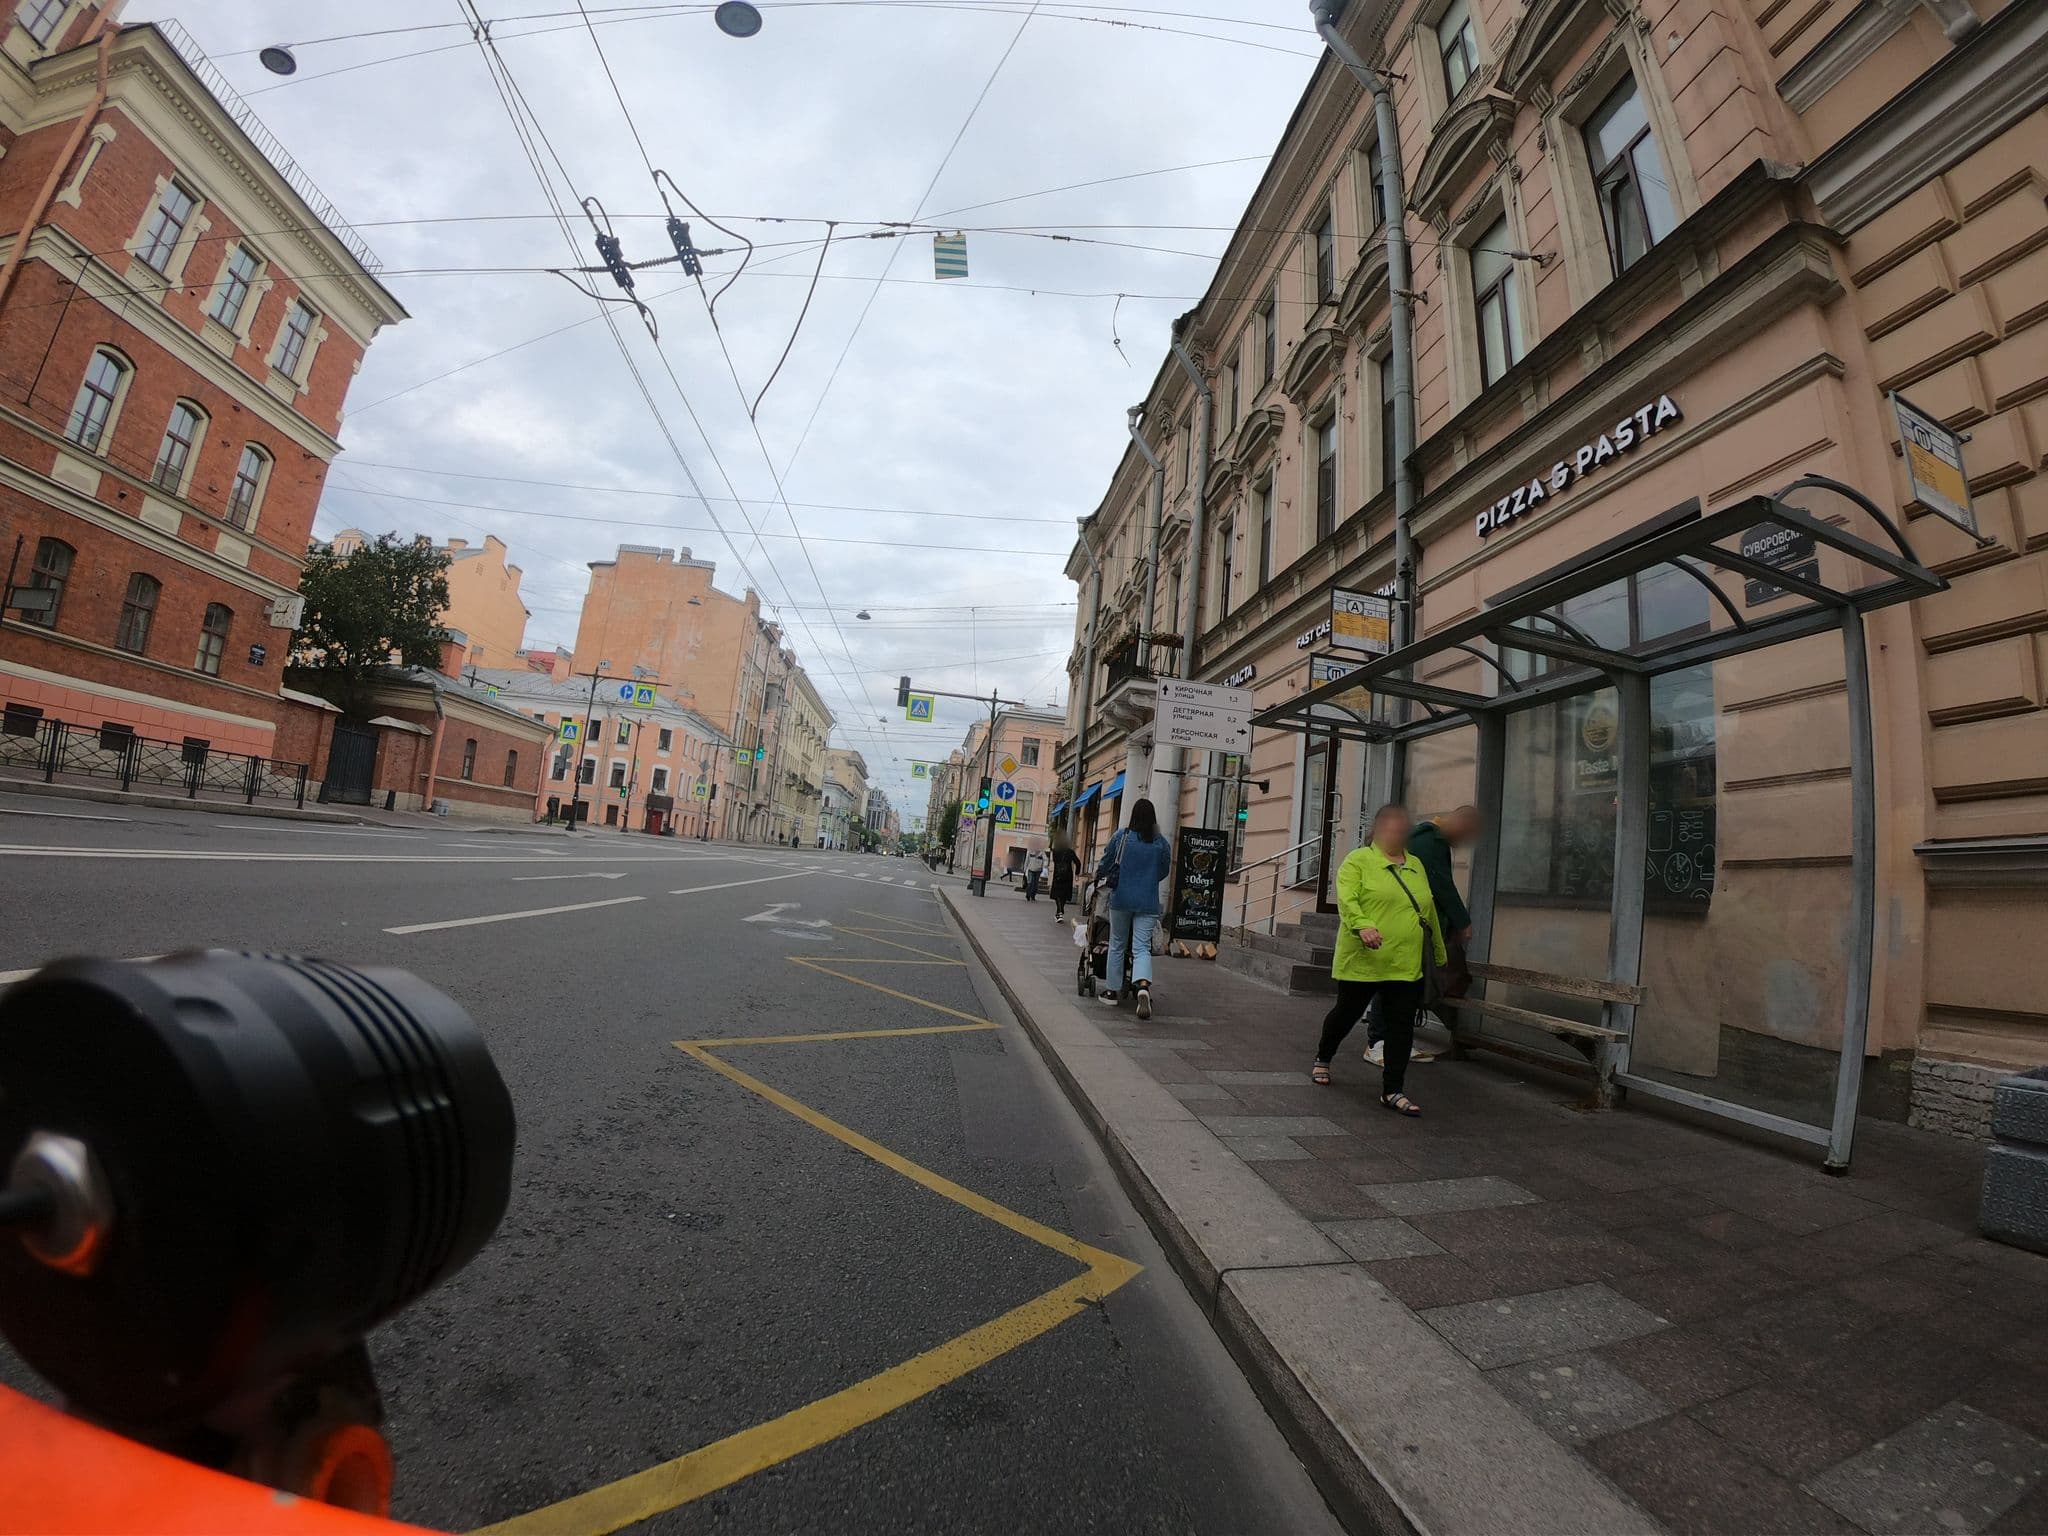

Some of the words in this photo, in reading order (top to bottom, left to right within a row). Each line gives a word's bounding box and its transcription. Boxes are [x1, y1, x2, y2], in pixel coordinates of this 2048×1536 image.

[1475, 478, 1545, 537] PIZZA
[1551, 461, 1569, 490] &
[1575, 394, 1678, 476] PASTA
[1763, 544, 1790, 558] ПРОСПЕКТ
[1296, 629, 1314, 649] FAST
[1230, 664, 1253, 687] ПАСТА
[1174, 685, 1213, 696] КИРОЧНАЯ
[1174, 692, 1195, 700] улица
[1172, 713, 1193, 721] улица
[1173, 706, 1214, 717] ДЕГТЯРНАЯ
[1171, 727, 1218, 739] ХЕРСОНСКАЯ
[1578, 759, 1609, 775] Taste
